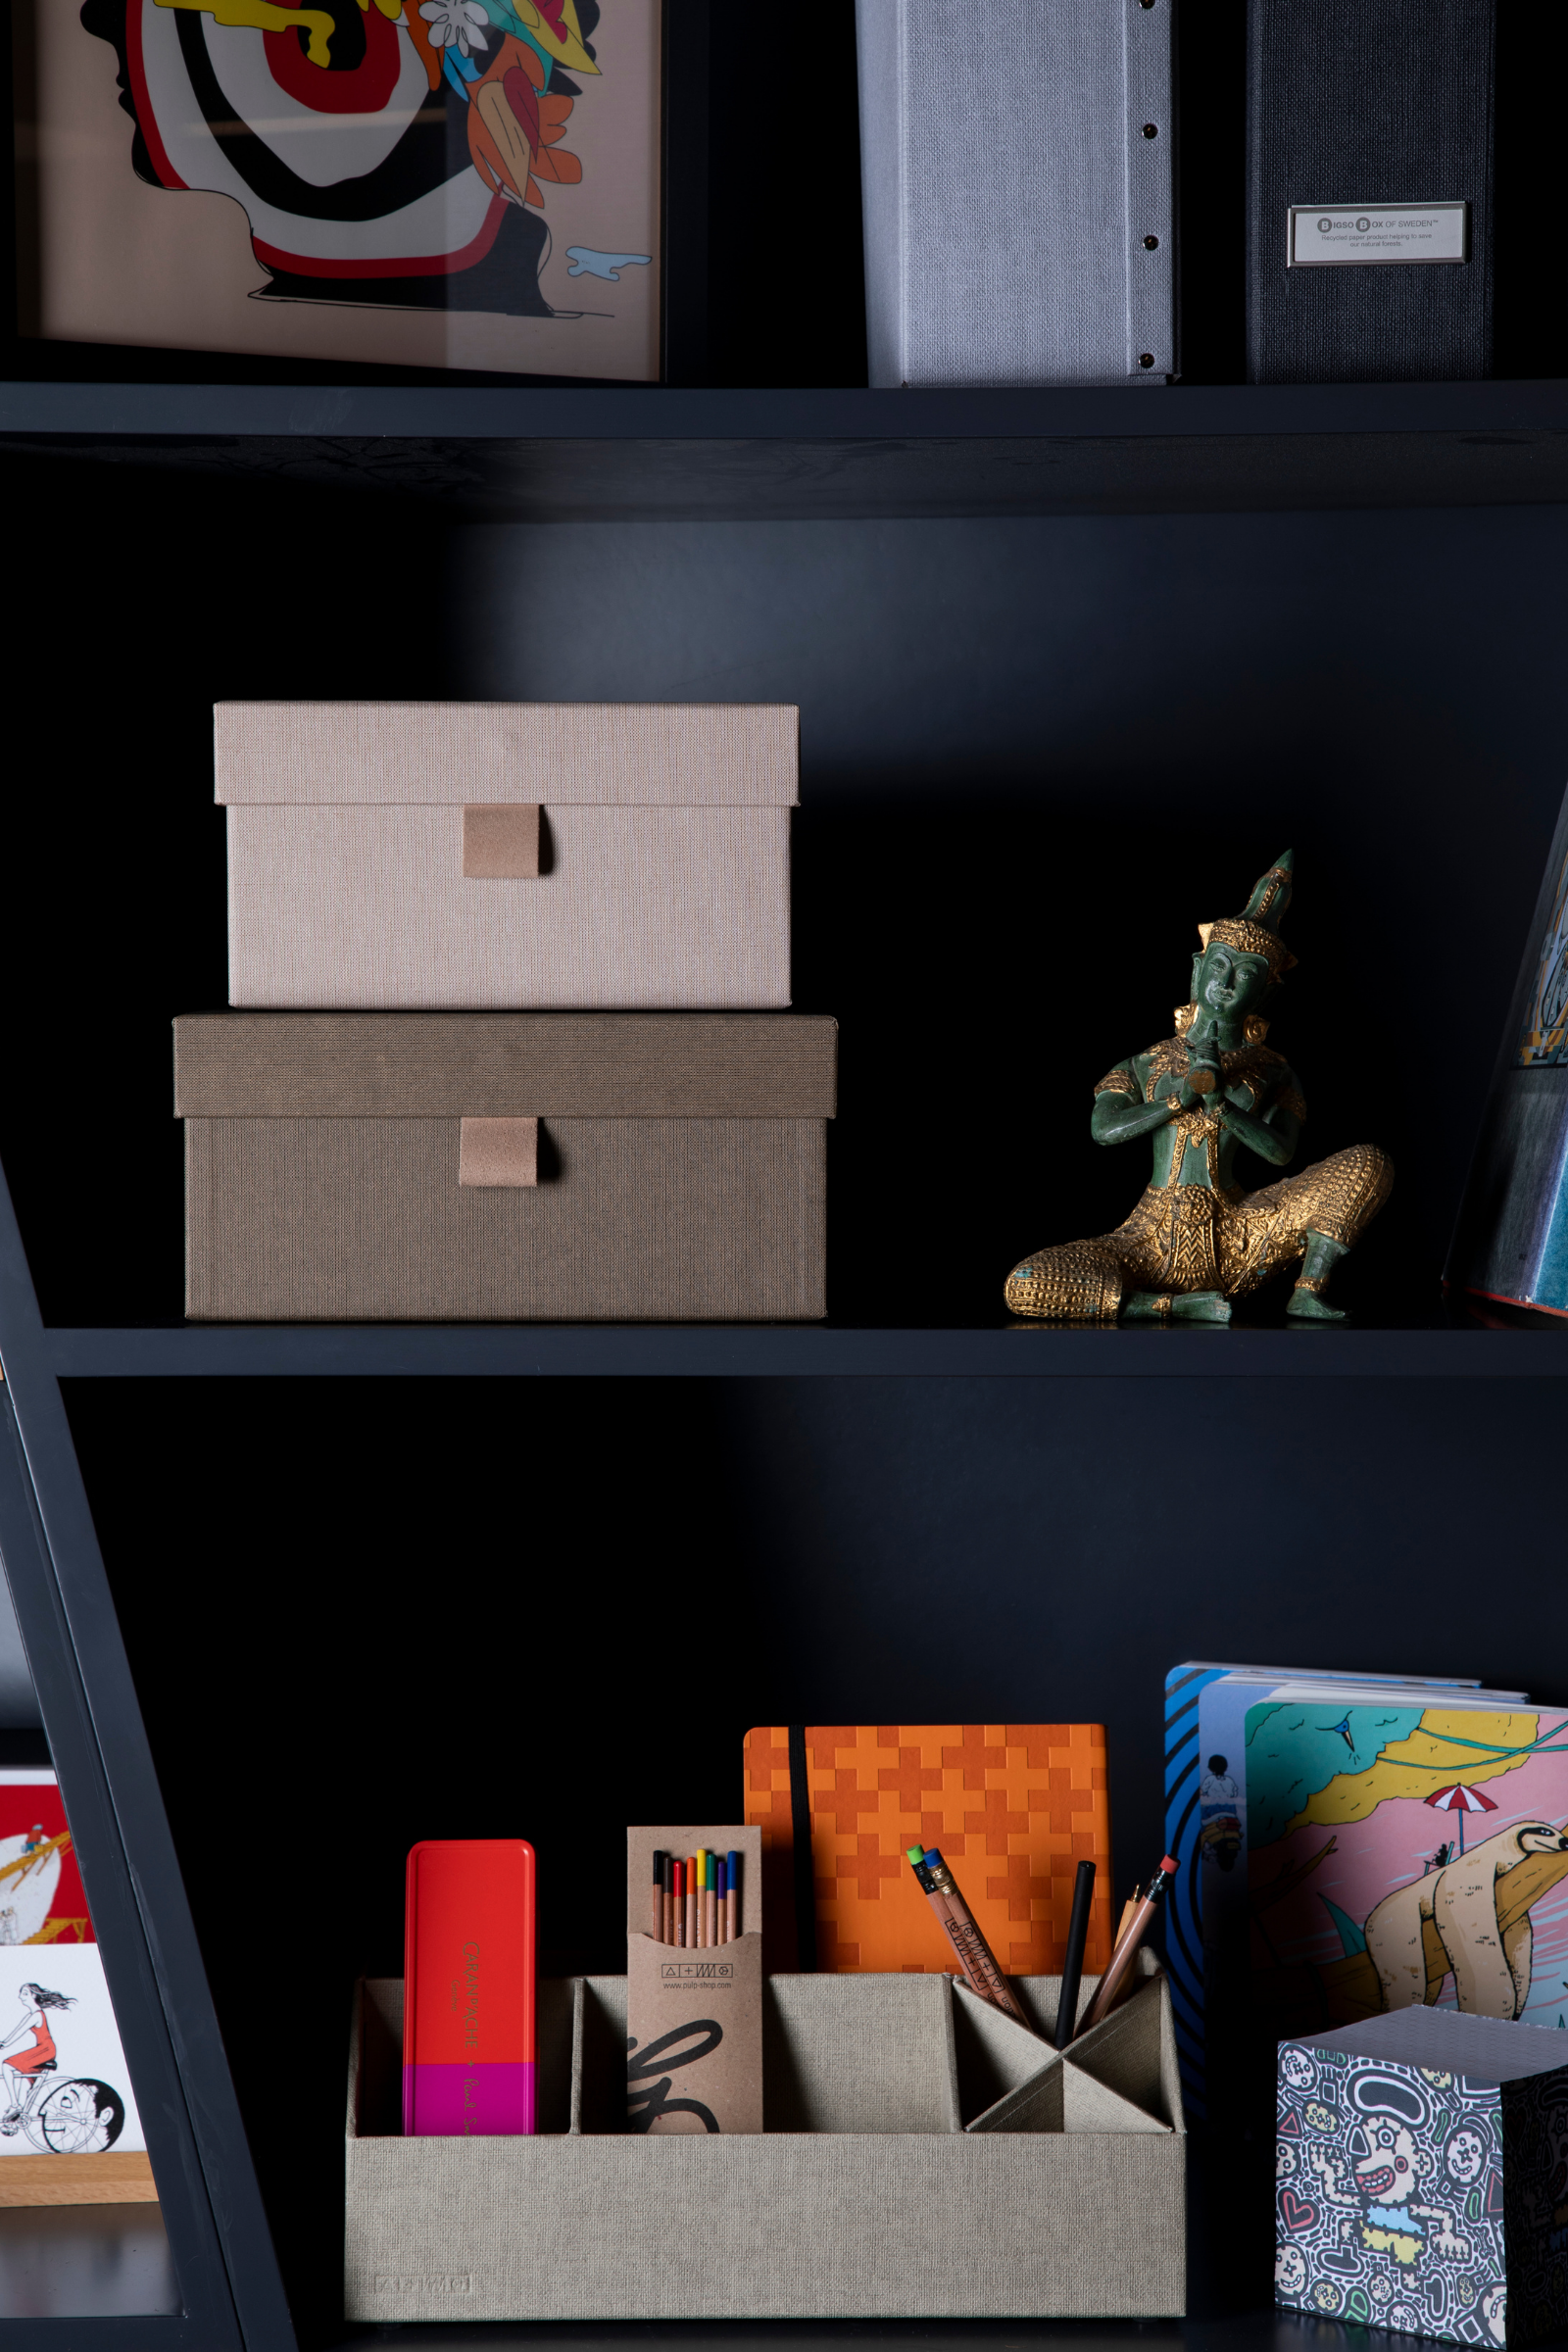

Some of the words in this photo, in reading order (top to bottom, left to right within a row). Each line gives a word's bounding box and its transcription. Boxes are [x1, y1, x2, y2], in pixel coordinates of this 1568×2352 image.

[1317, 218, 1353, 233] BIGSO
[1355, 217, 1383, 232] BOX
[463, 1941, 480, 1996] CARAN
[451, 1980, 461, 2012] Genève
[662, 1982, 732, 1990] www.pulp-shop.com
[464, 2079, 480, 2111] Paul
